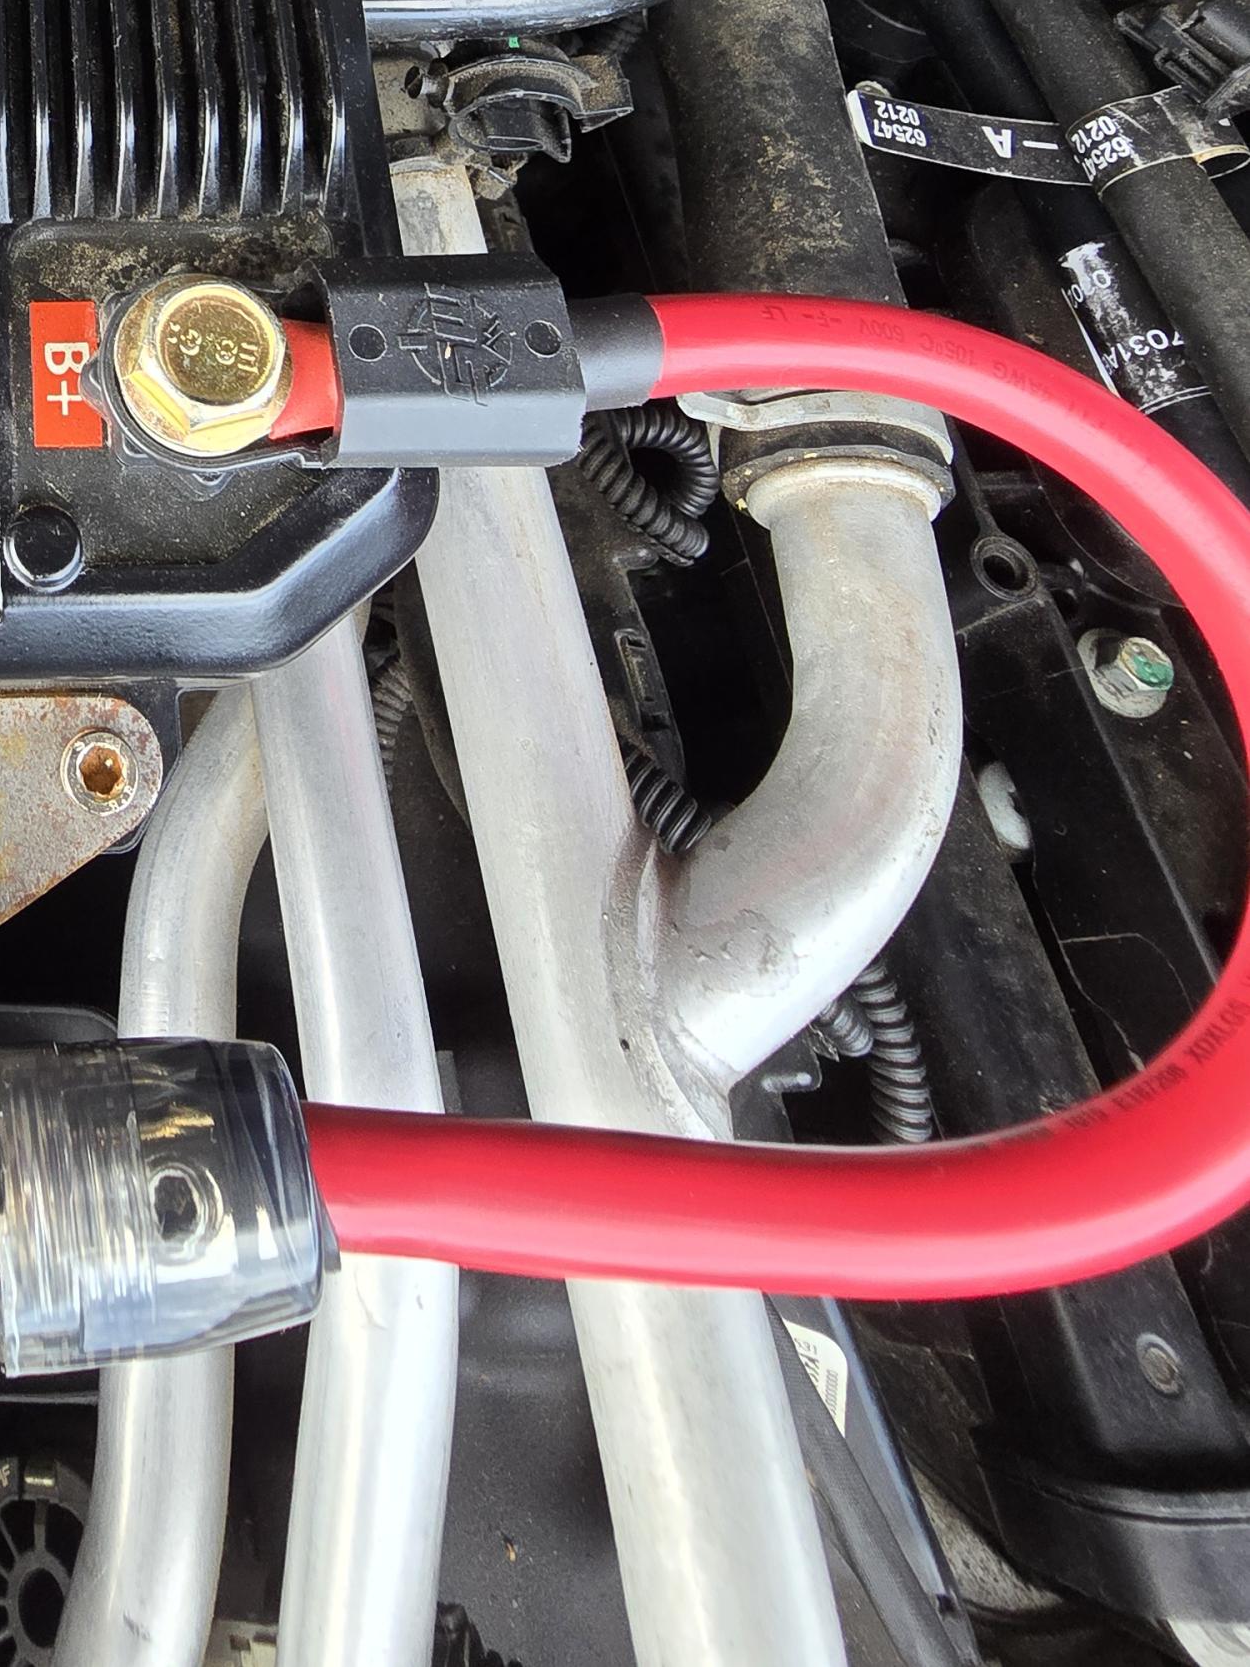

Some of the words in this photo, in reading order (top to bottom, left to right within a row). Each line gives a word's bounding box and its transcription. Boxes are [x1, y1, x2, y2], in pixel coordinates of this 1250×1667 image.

[873, 99, 922, 127] 0212
[872, 118, 927, 148] 62547
[1070, 115, 1116, 153] 0212
[43, 341, 91, 416] B+
